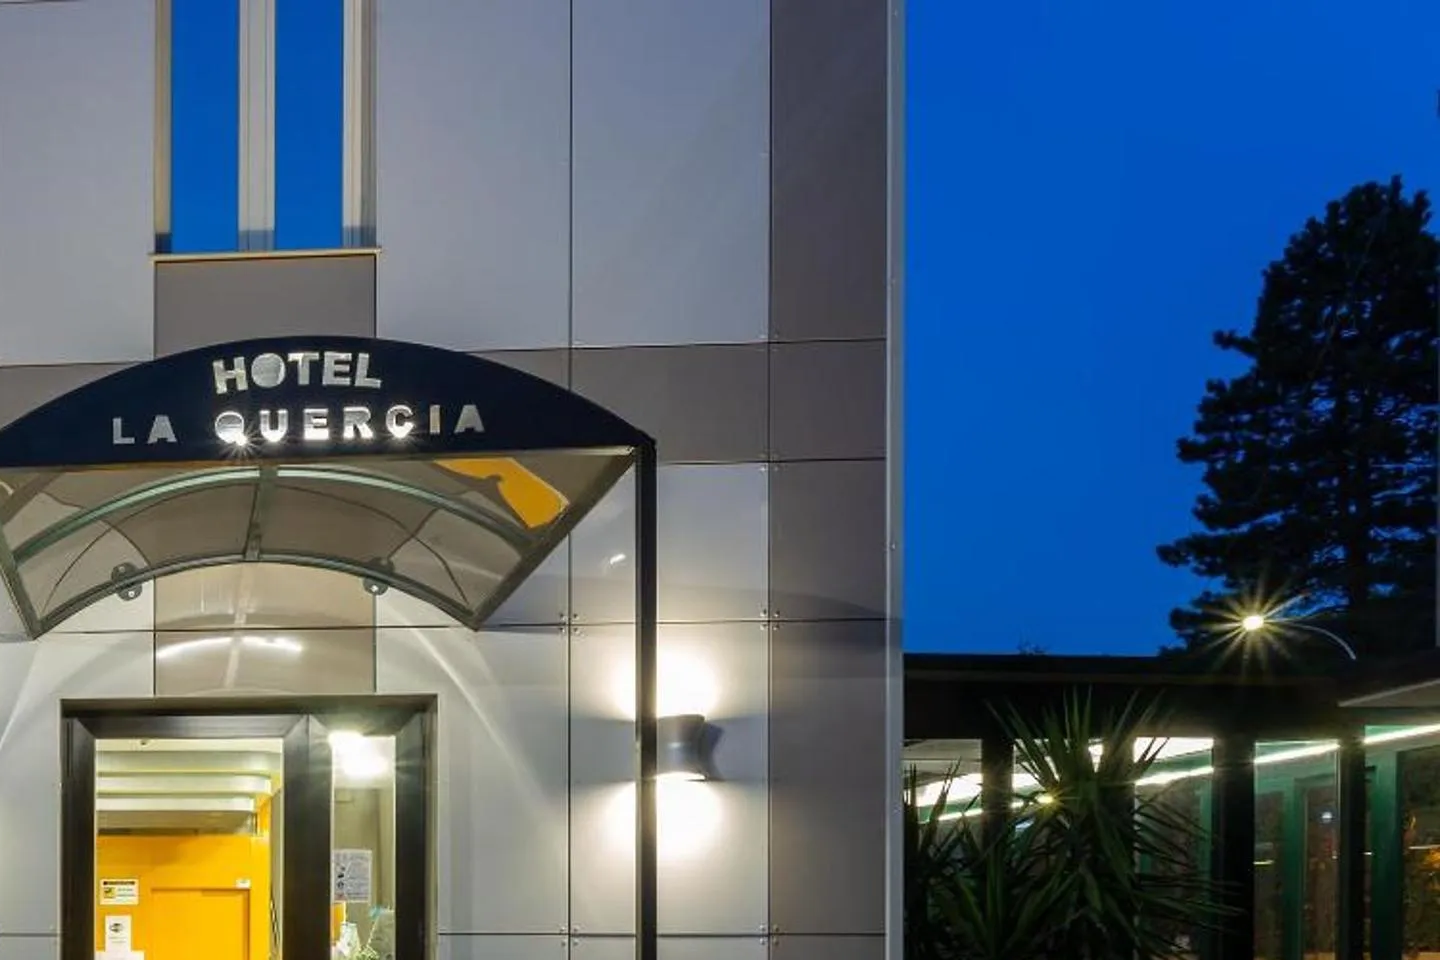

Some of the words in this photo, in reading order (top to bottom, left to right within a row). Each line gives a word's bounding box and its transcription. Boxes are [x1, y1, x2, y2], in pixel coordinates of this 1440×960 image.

[212, 351, 382, 395] HOTEL
[112, 415, 178, 444] LA
[214, 404, 485, 446] QUERCIA
